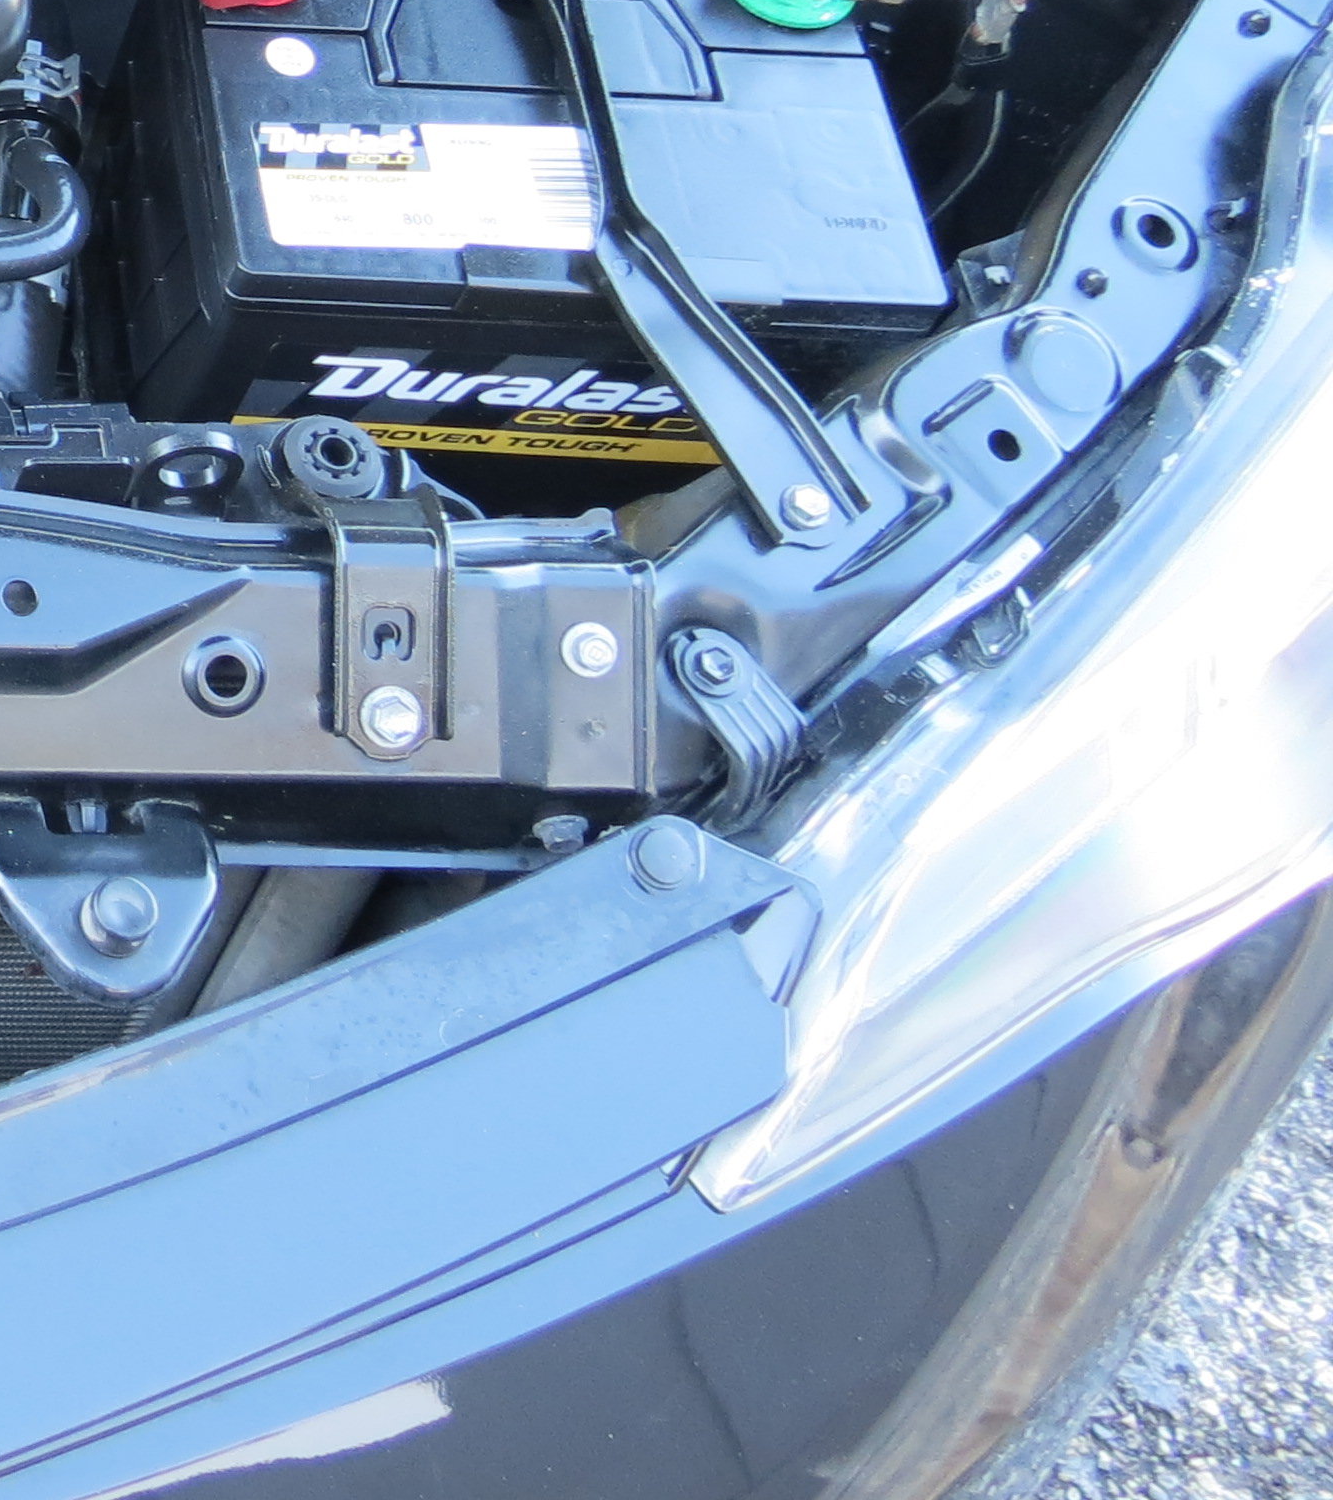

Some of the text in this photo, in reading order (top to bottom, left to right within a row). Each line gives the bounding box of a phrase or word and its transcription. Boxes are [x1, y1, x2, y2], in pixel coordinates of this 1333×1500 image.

[259, 126, 416, 155] Duralast
[348, 153, 416, 165] GOLD
[286, 173, 407, 184] PROVEN TOUGH
[402, 213, 434, 226] 800
[309, 355, 687, 414] Duralas
[511, 409, 699, 433] GOLD
[362, 428, 631, 454] ROVEN TOUGH
